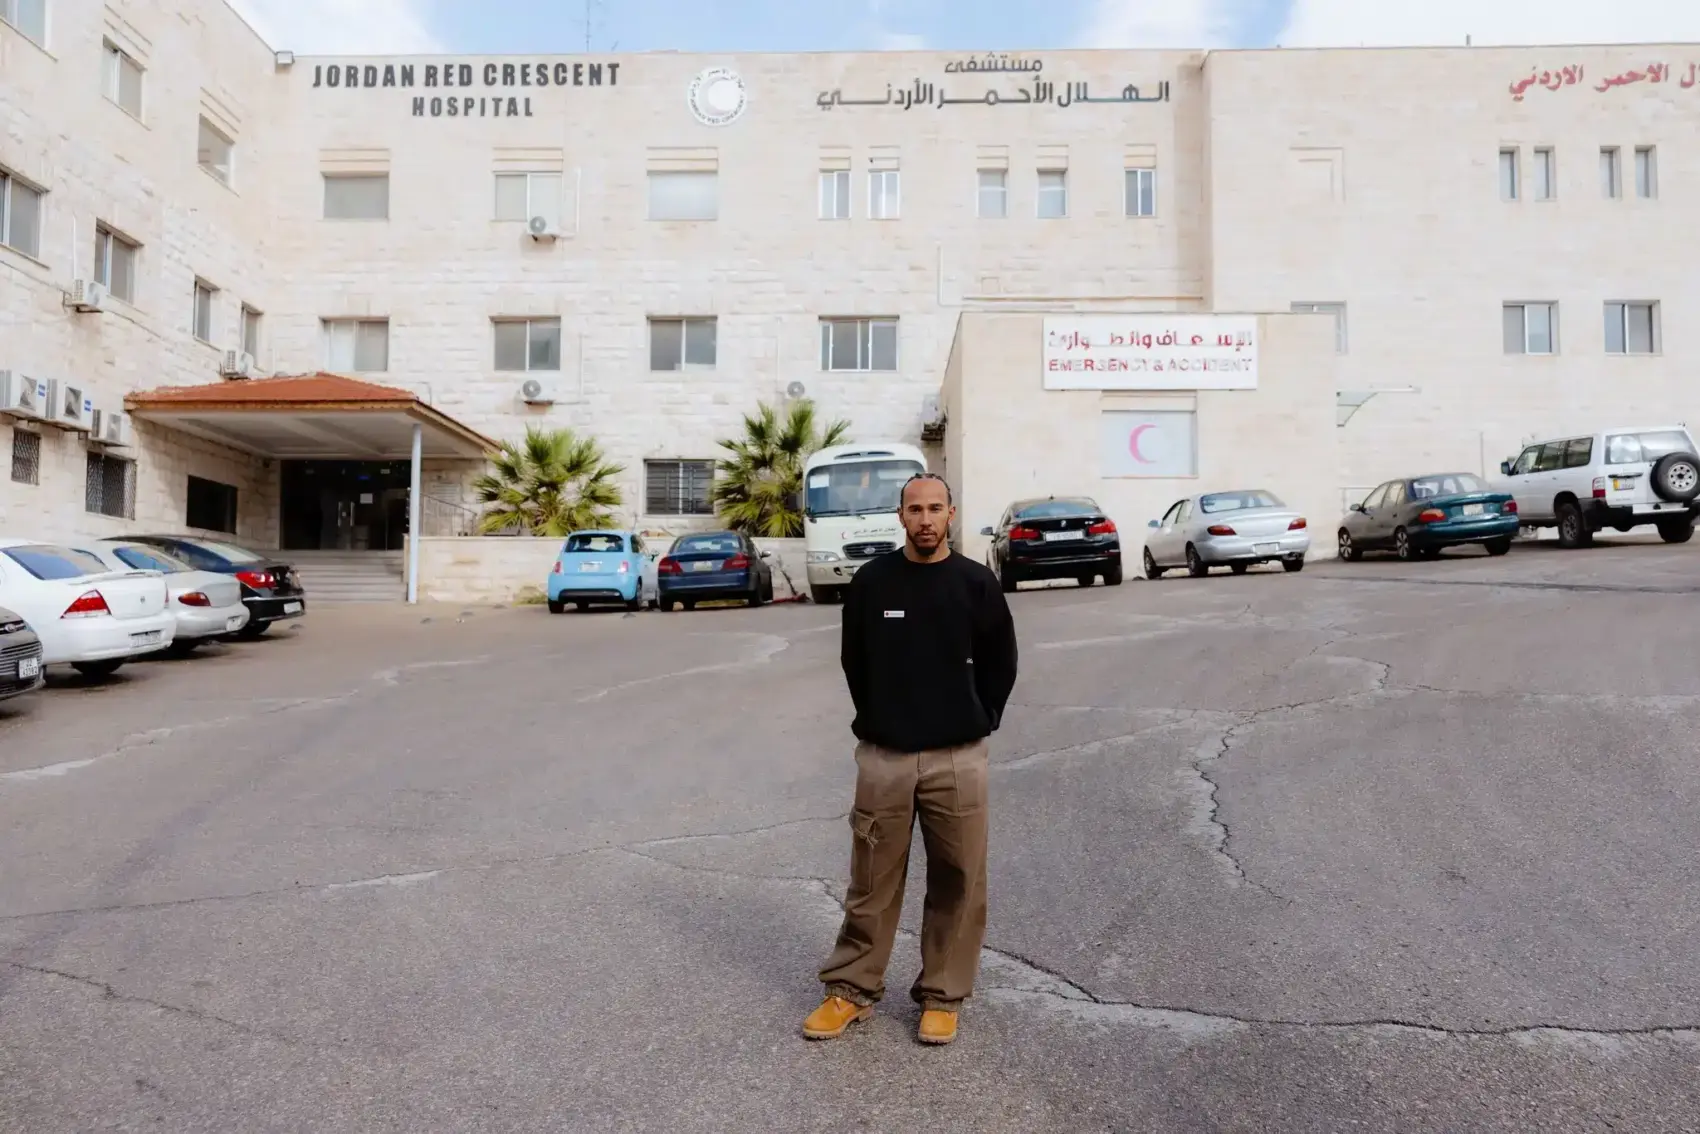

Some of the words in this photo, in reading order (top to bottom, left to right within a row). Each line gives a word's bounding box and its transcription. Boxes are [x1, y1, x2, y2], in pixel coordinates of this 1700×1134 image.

[312, 64, 415, 88] JORDAN
[424, 64, 473, 87] RED
[483, 62, 620, 87] CRESCENT
[944, 52, 1043, 74] مستشفى
[815, 77, 933, 111] الأردني
[936, 75, 1053, 109] الأحمر
[1057, 80, 1170, 108] الهلال
[411, 96, 534, 117] HOSPITAL
[1048, 358, 1150, 372] EMERGENCY
[1153, 359, 1164, 372] &
[1167, 358, 1253, 372] ACCIDENT
